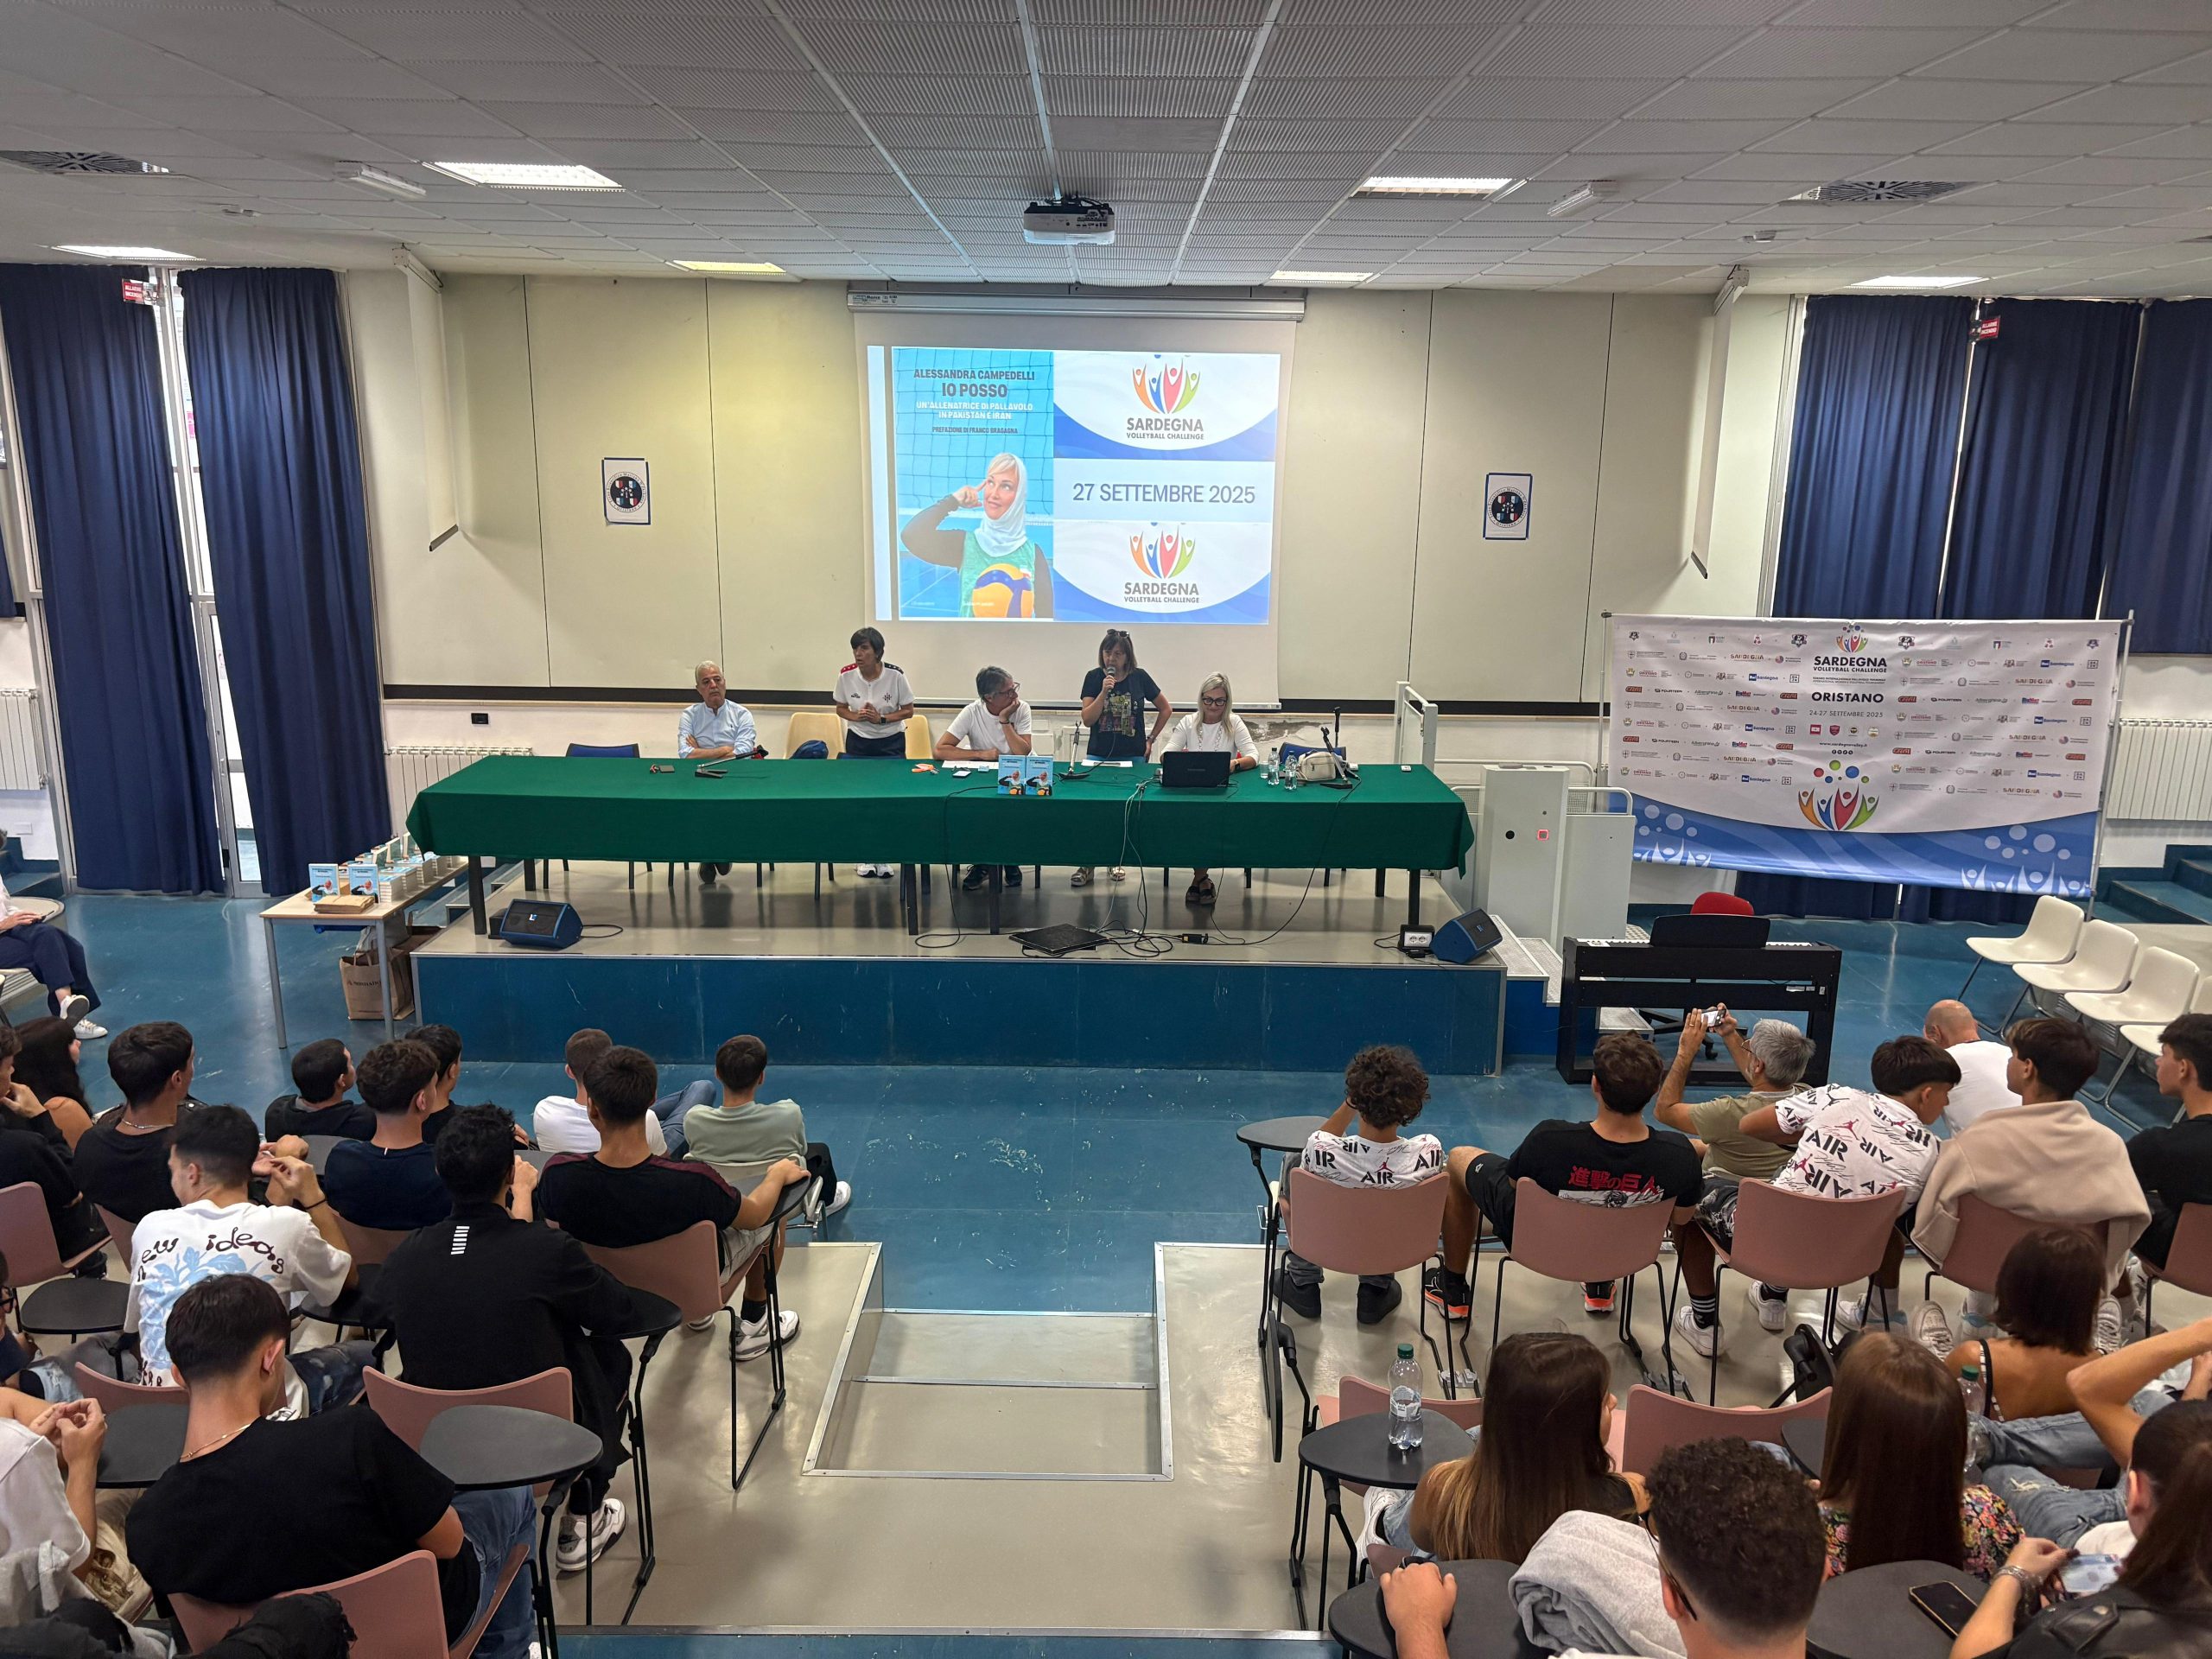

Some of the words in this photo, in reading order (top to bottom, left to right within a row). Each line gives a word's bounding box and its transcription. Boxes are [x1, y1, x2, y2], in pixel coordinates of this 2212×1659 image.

[913, 369, 976, 379] ALESSANDRA
[978, 371, 1035, 381] CAMPEDELLI
[942, 383, 957, 397] IO
[960, 383, 1007, 398] POSSO
[916, 401, 980, 410] UN'ALLENATRICE
[990, 403, 1033, 411] PALLAVOLO
[949, 411, 986, 420] PAKISTAN
[1127, 417, 1204, 432] SARDEGNA
[1072, 483, 1095, 501] 27
[1100, 483, 1205, 503] SETTEMBRE
[1209, 485, 1255, 504] 2025
[1124, 582, 1199, 596] SARDEGNA
[1814, 656, 1887, 667] SARDEGNA
[1811, 691, 1884, 703] ORISTANO
[1805, 1129, 1848, 1162] AIR
[1859, 1136, 1895, 1163] AIR
[1360, 1171, 1395, 1185] AIR
[1568, 1165, 1659, 1196] 進撃の巨人
[206, 1226, 284, 1274] ideas
